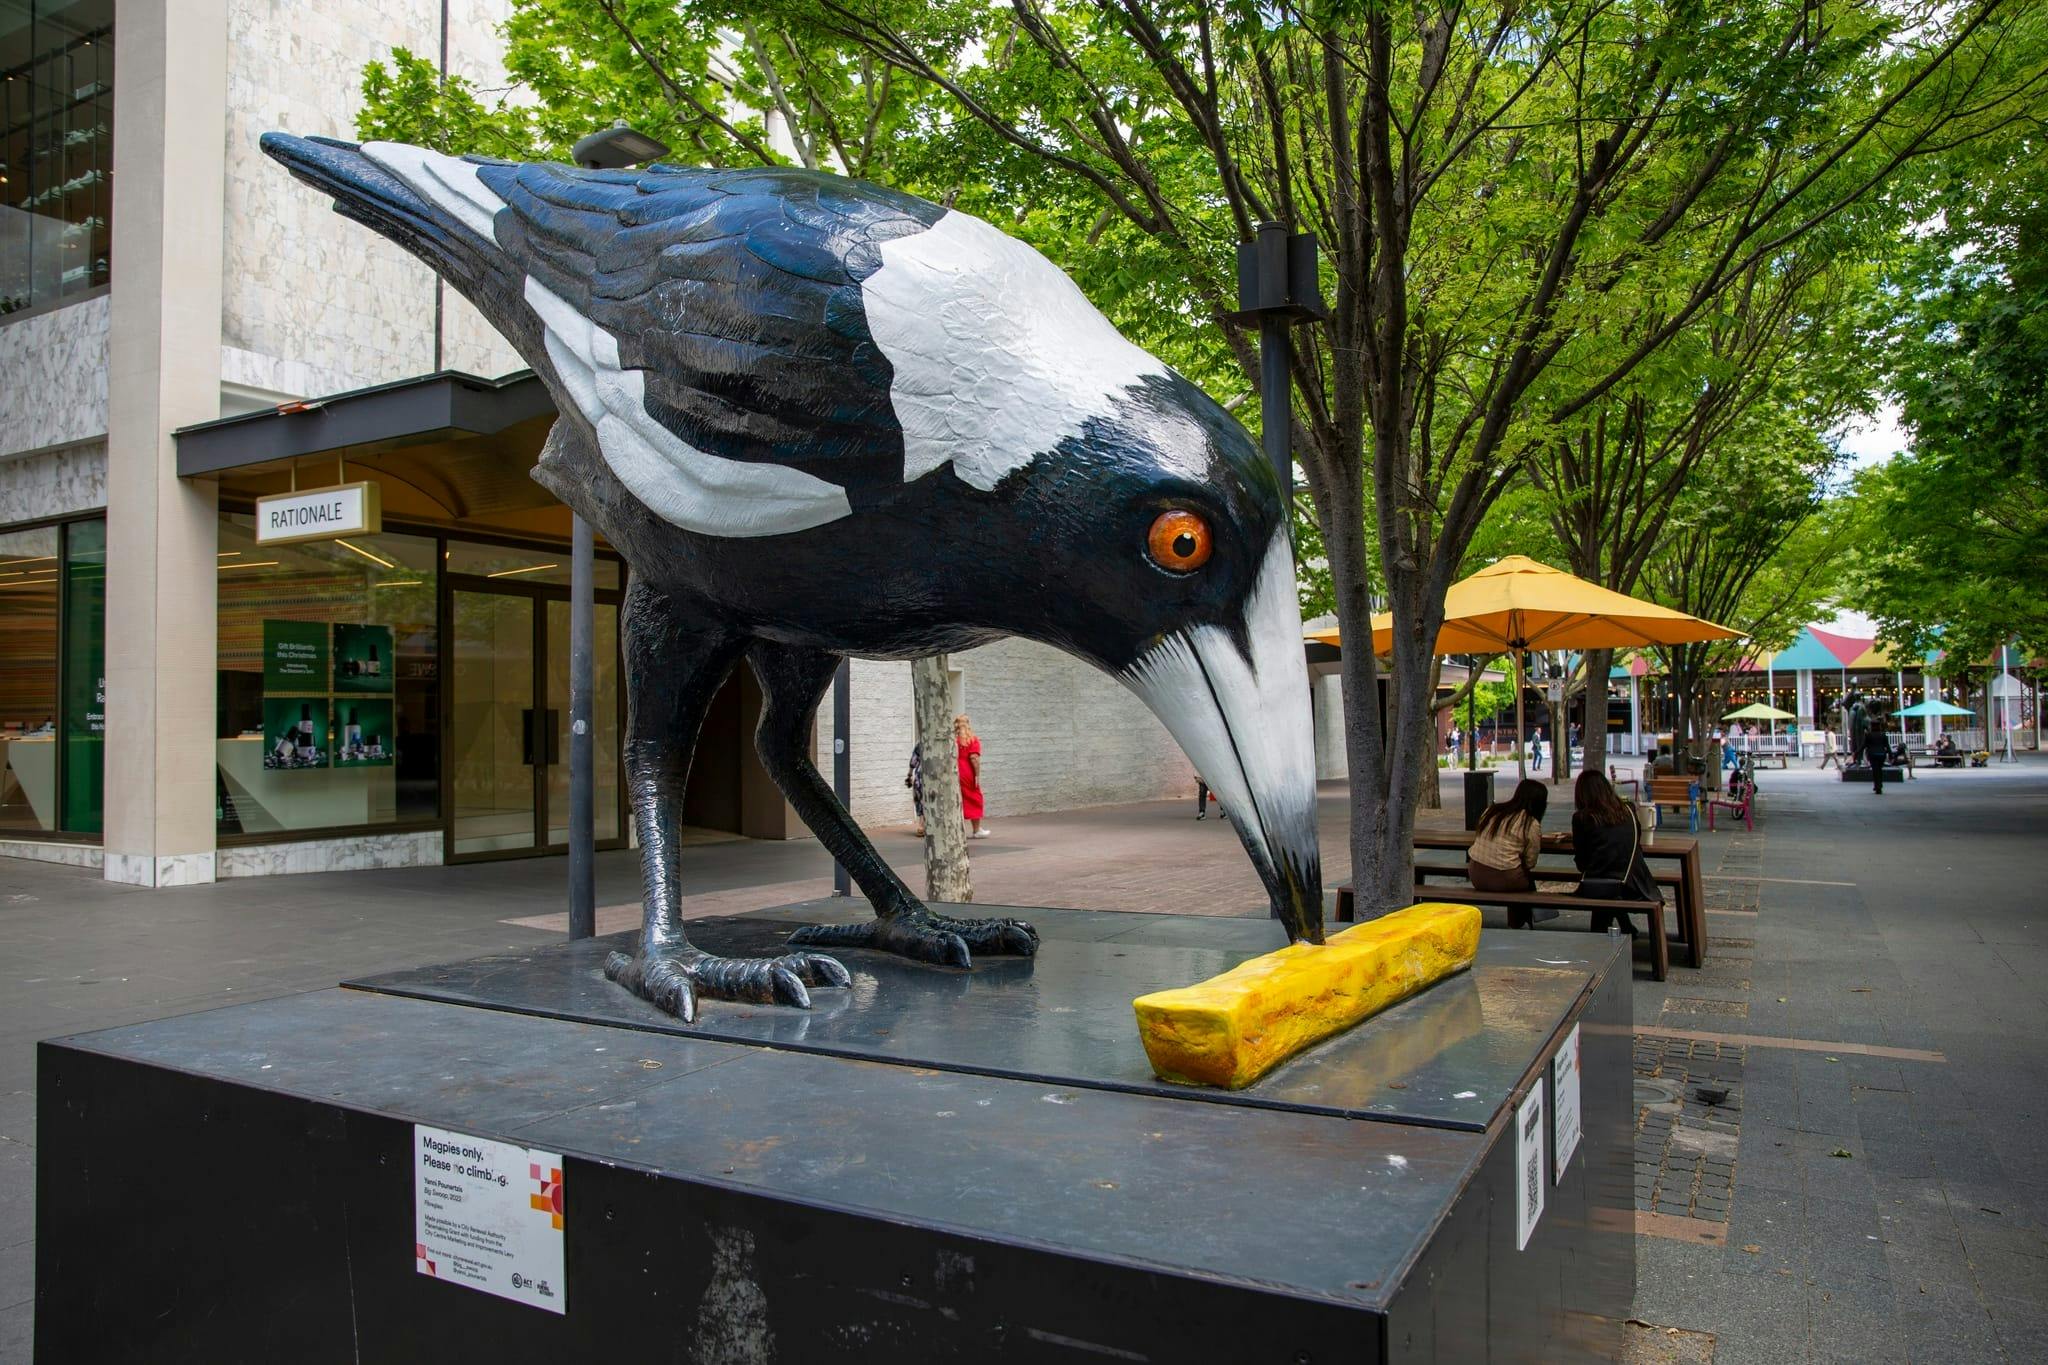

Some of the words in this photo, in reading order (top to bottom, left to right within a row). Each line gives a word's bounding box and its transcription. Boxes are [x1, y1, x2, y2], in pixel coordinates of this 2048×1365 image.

[271, 501, 343, 529] RATIONALE
[288, 651, 317, 659] Christmas
[423, 1136, 461, 1155] Magpies
[462, 1146, 484, 1162] only.
[423, 1154, 451, 1171] Please
